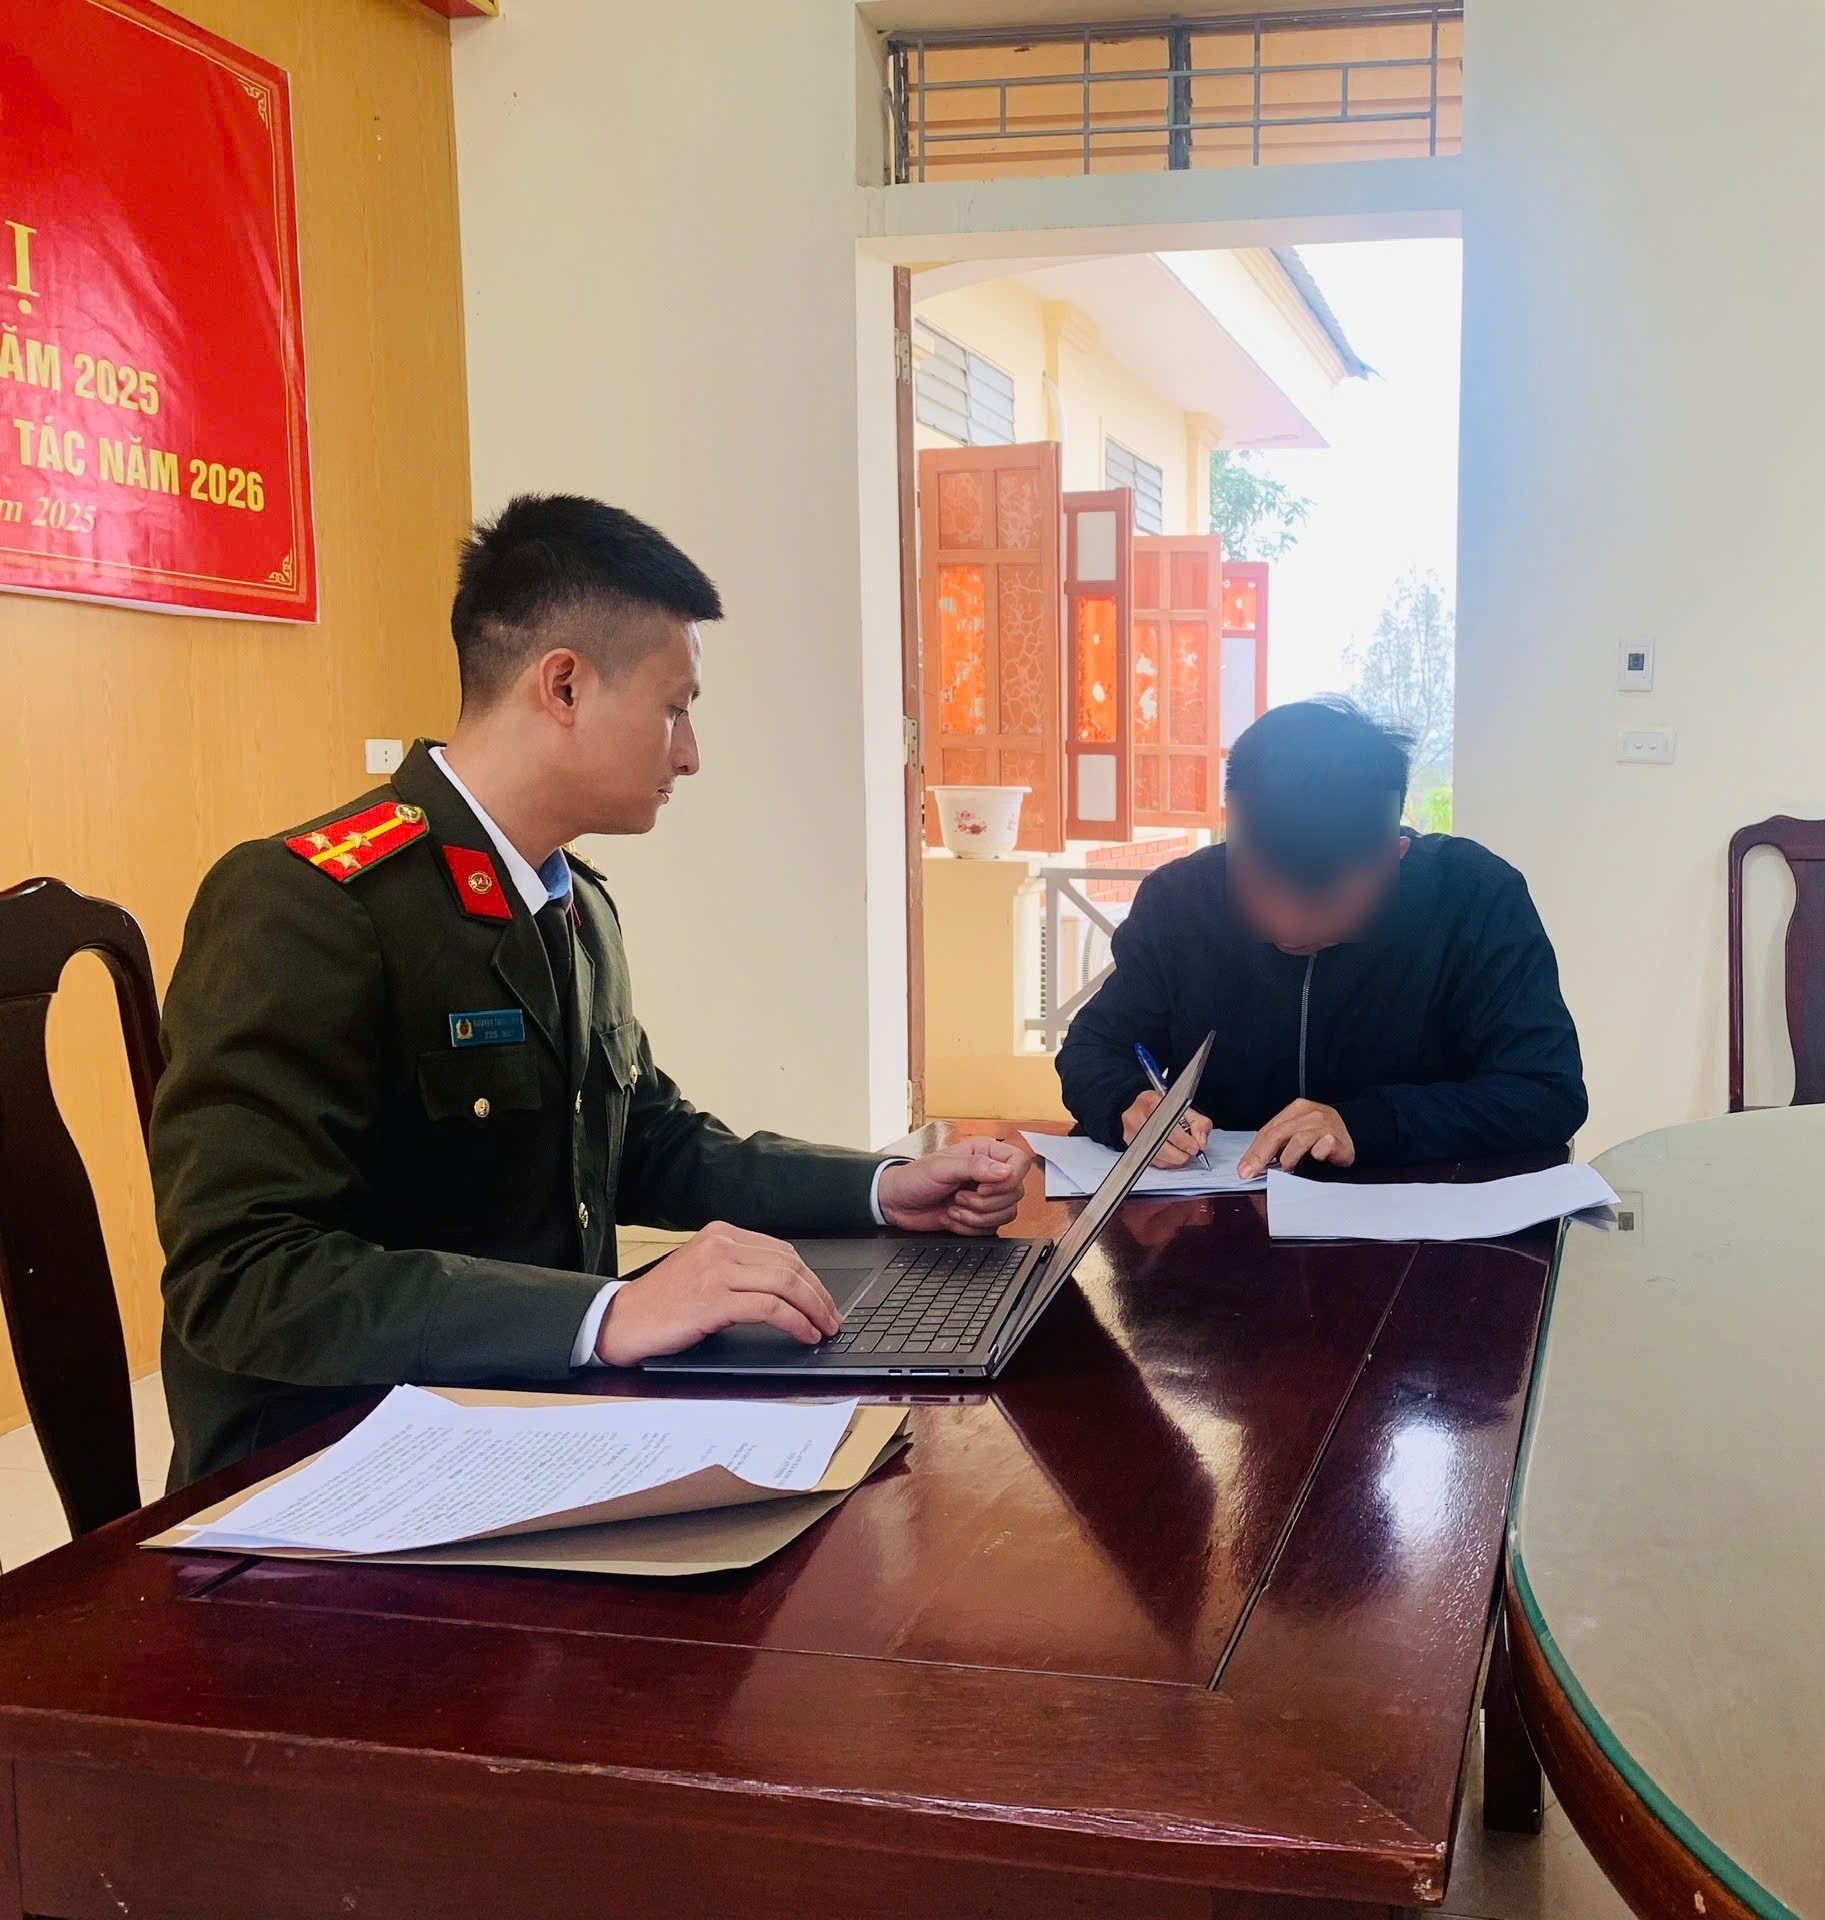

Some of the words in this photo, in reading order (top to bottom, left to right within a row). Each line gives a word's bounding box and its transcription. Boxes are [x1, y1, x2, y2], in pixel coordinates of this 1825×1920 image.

[5, 219, 40, 315] Ị
[73, 353, 160, 415] 2025
[13, 416, 87, 476] TÁC
[98, 434, 180, 495] NĂM
[189, 458, 264, 512] 2026
[31, 496, 96, 534] 2025
